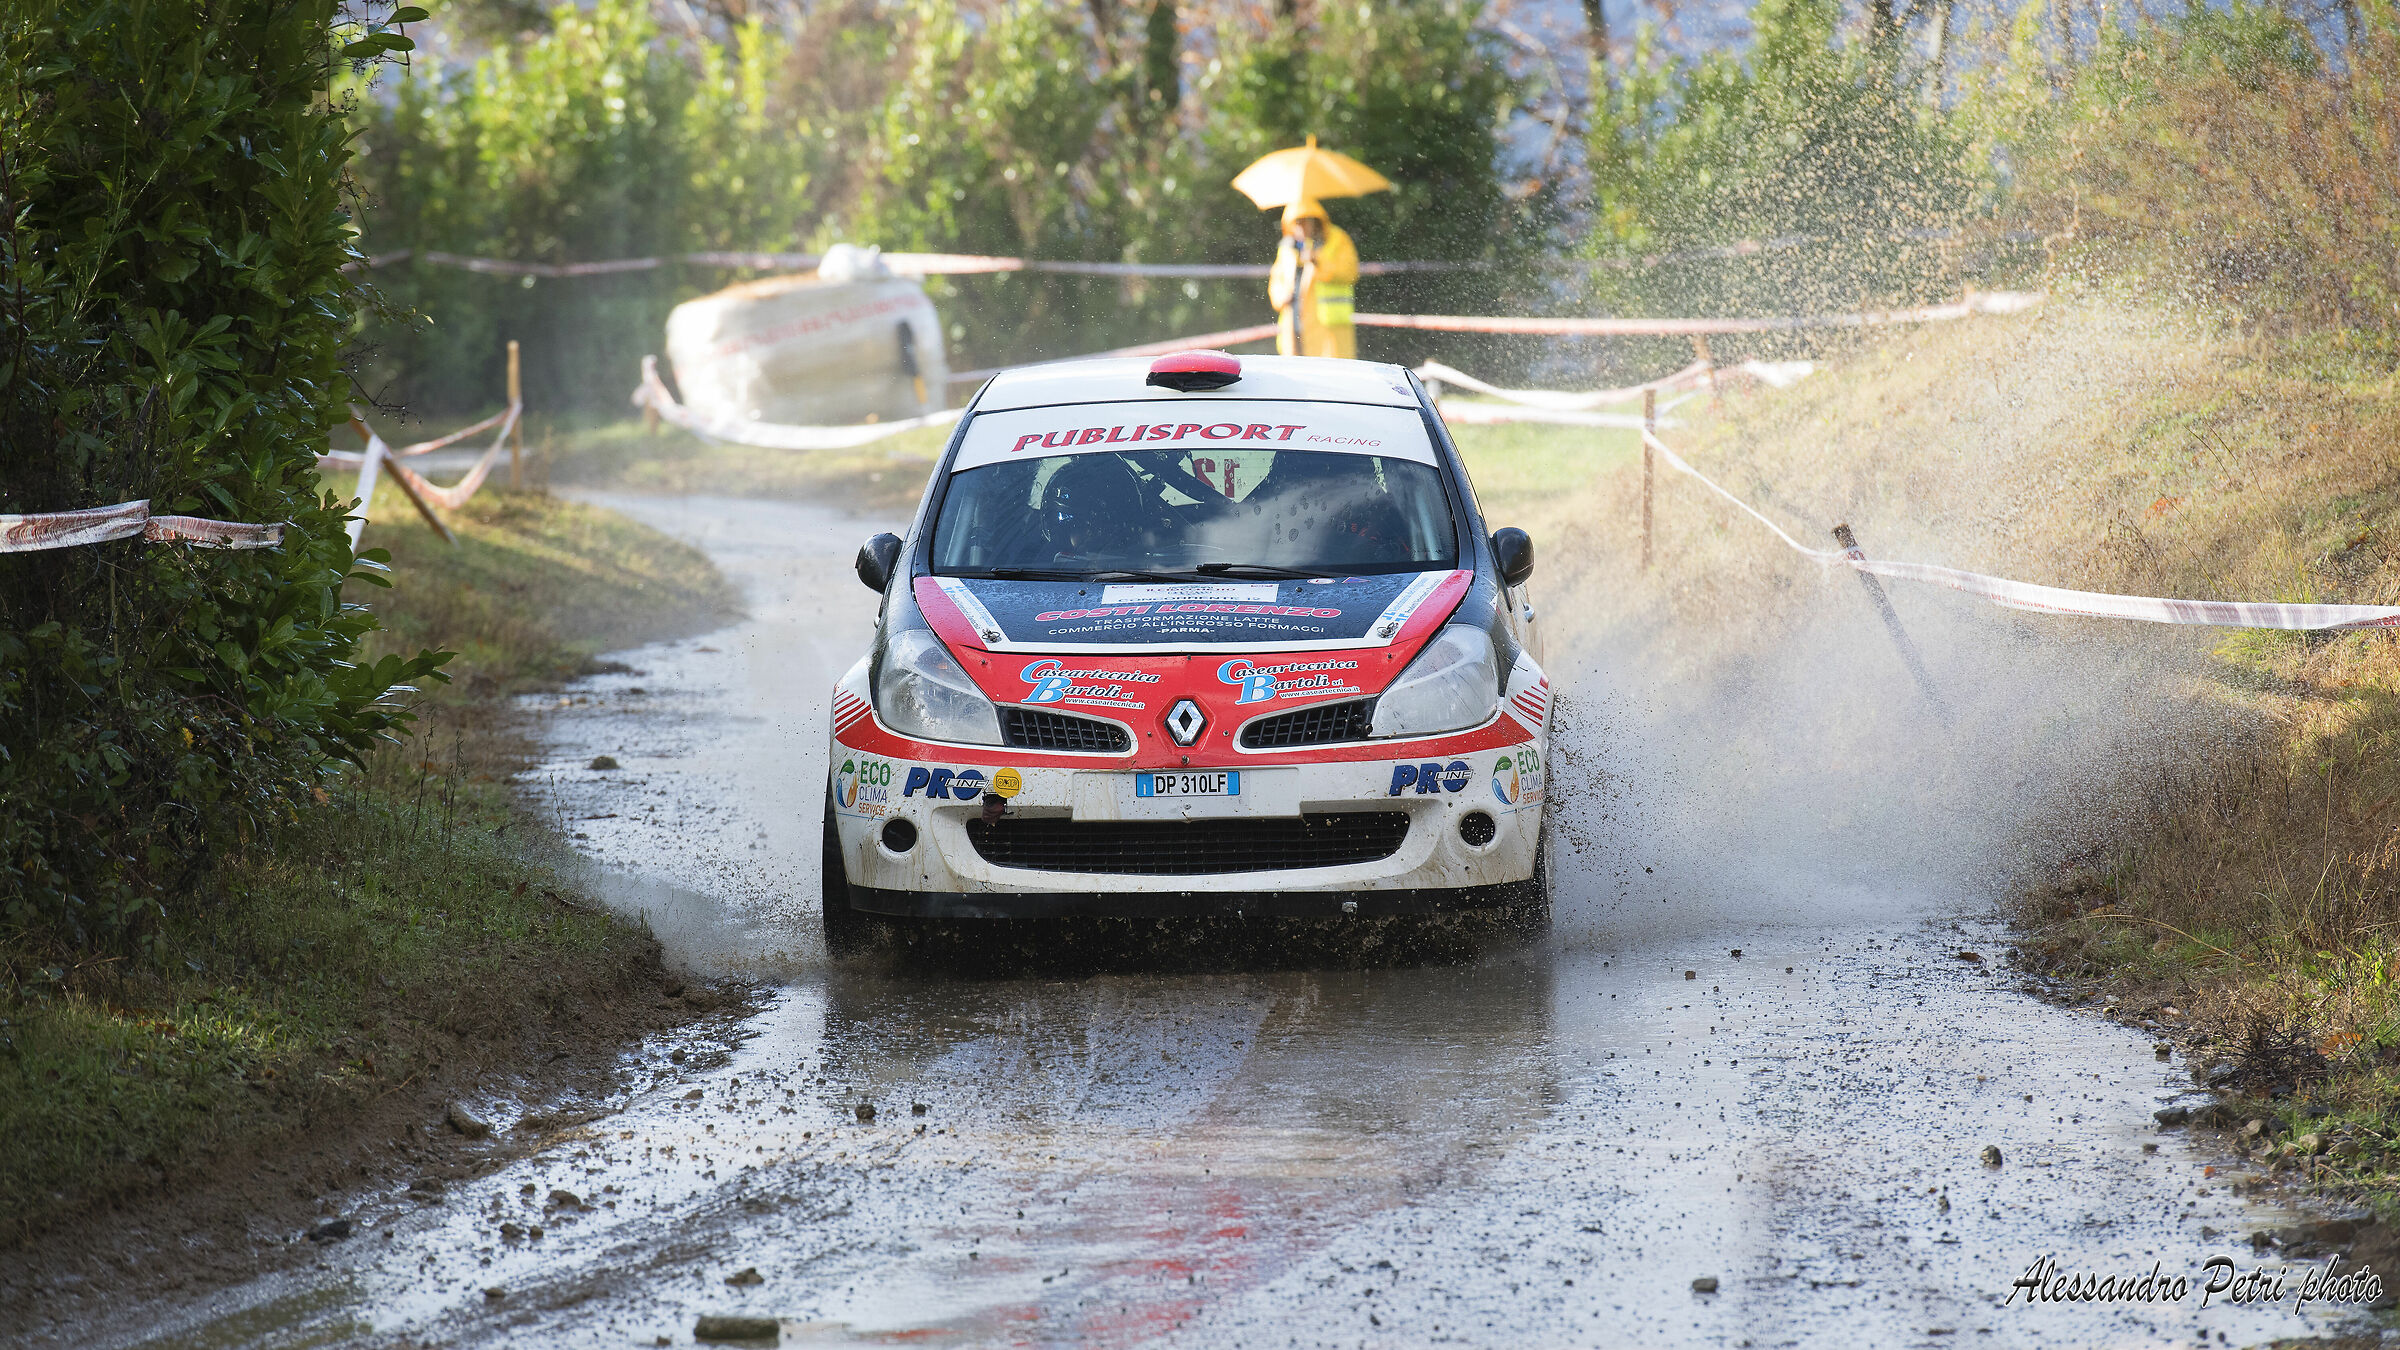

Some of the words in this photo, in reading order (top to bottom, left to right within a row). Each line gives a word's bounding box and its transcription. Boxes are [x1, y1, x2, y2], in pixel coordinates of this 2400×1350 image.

[1012, 423, 1306, 452] PUBLISPORT
[1307, 434, 1382, 448] RACING
[1034, 605, 1153, 622] COSTI
[1155, 603, 1342, 619] LORENZO
[1094, 614, 1229, 625] TRASFORMAZIONE
[1233, 616, 1280, 624] LATTE
[1048, 622, 1137, 635] COMMERCIO
[1141, 620, 1244, 628] ALL'INGROSSO
[1248, 622, 1325, 633] FORMAGGI
[1020, 659, 1161, 684] Caseartecnica
[1217, 658, 1358, 684] Caseartecnica
[1021, 676, 1122, 703] Bartoli
[1121, 691, 1134, 699] srl
[1235, 674, 1329, 705] Bartoli
[1331, 679, 1344, 687] srl
[1280, 686, 1360, 699] www.caseartecnica.it
[1065, 697, 1145, 709] www.caseartecnica.it
[1516, 749, 1540, 775] ECO
[860, 761, 891, 787] ECO
[902, 766, 986, 800] PRO
[1155, 775, 1176, 793] DP
[1181, 774, 1227, 793] 310LF
[1388, 760, 1471, 797] PRO
[1434, 769, 1474, 781] LINE
[1520, 773, 1543, 791] CLIMA
[945, 778, 989, 790] LINE
[858, 786, 888, 803] CLIMA
[858, 802, 887, 816] SERVICE
